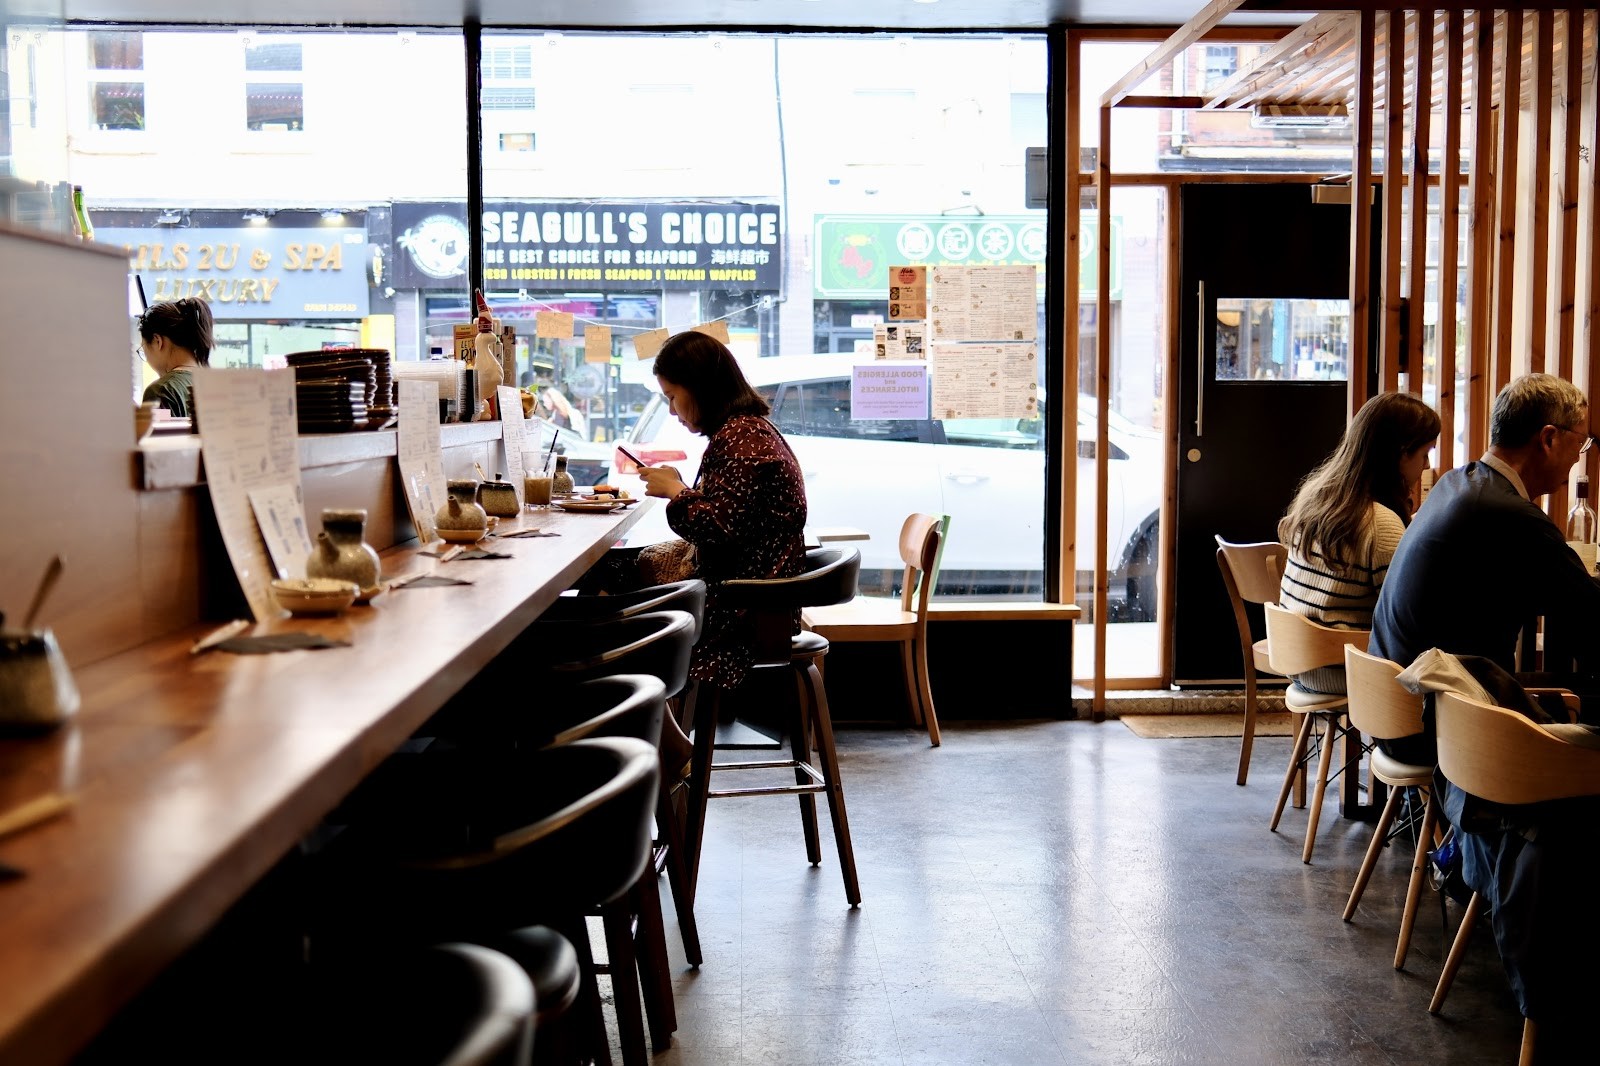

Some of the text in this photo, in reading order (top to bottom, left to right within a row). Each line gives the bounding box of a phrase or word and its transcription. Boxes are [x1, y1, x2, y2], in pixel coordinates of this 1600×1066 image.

[482, 211, 648, 243] SEAGULL'S
[661, 212, 777, 245] CHOICE
[197, 243, 240, 270] 2U
[249, 248, 272, 271] &
[283, 243, 344, 271] SPA
[486, 249, 697, 264] HE BEST CHOICE FOR SEAFOOD
[511, 269, 558, 280] LOBSTER
[567, 269, 602, 280] FRESH
[605, 269, 653, 281] SEAFOOD
[709, 269, 757, 281] WAFFLES
[152, 276, 280, 302] LUXURY
